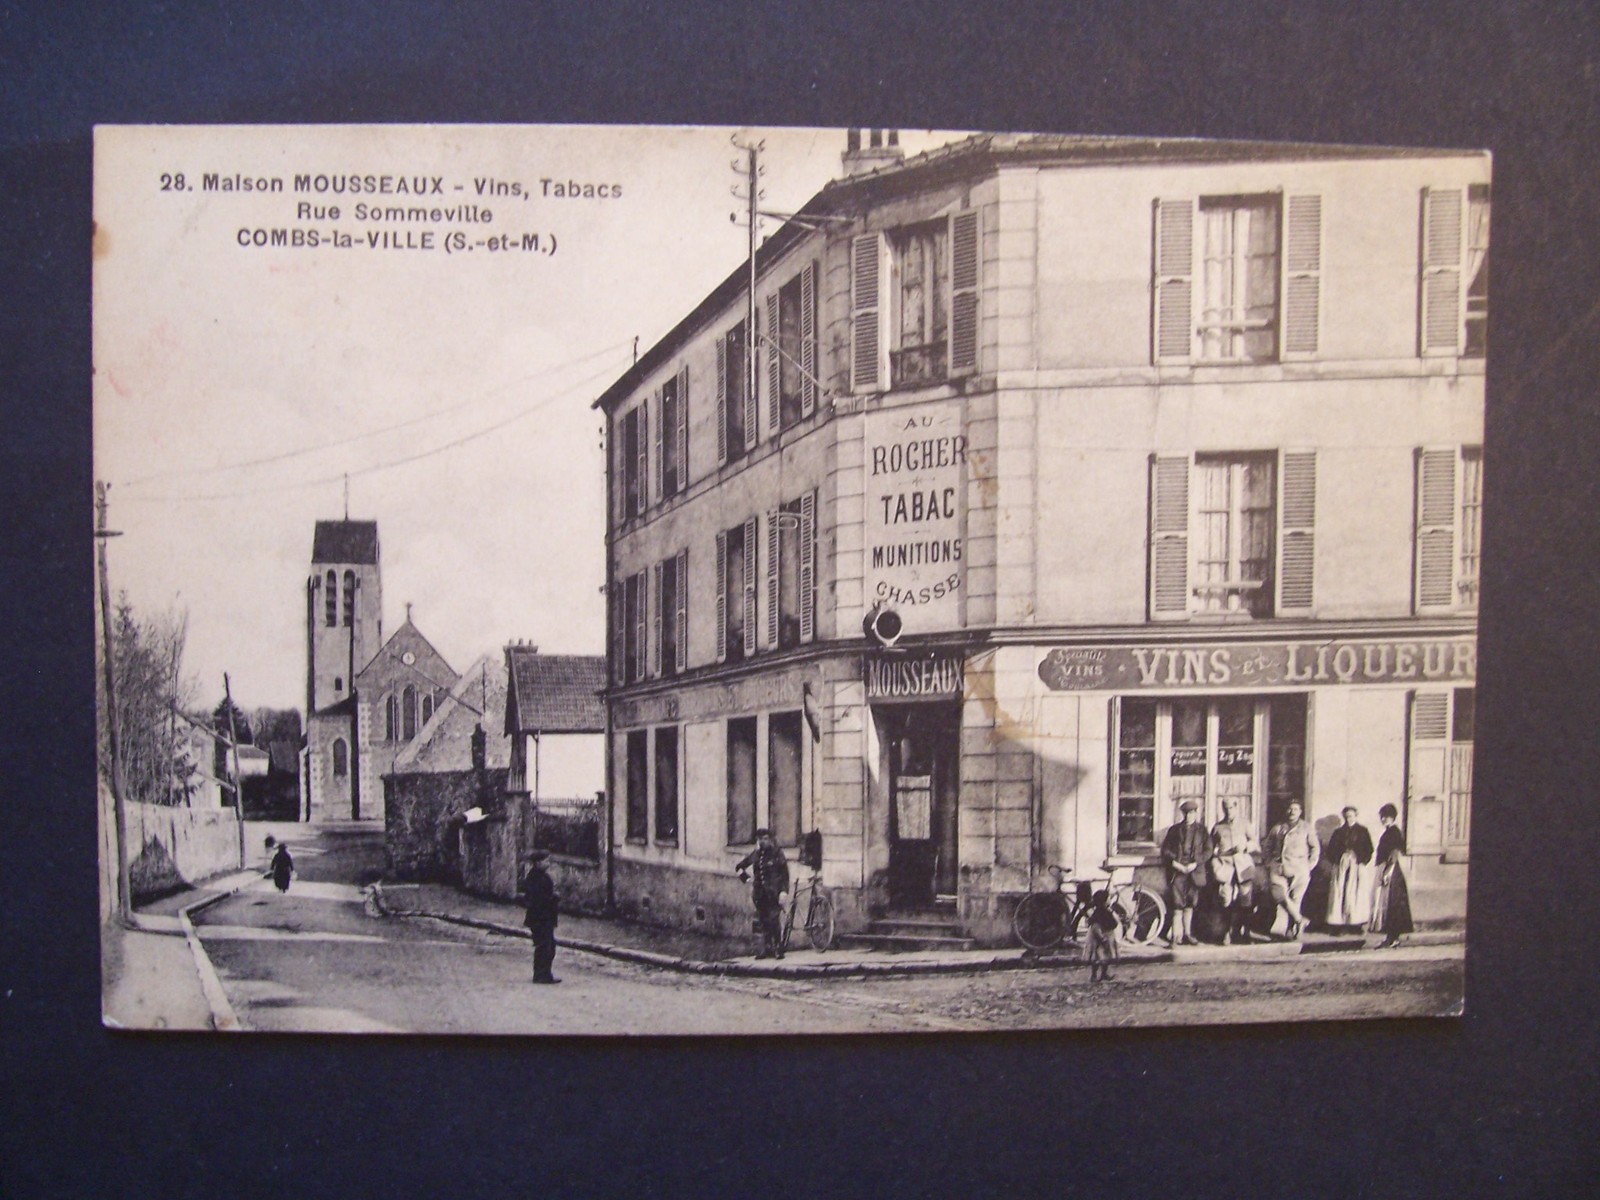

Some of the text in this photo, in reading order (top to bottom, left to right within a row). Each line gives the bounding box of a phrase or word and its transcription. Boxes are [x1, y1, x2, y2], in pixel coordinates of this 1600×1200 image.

[903, 415, 934, 432] AU
[872, 435, 969, 476] ROCHER
[881, 487, 956, 525] TABAC
[872, 538, 963, 569] MUNITIONS
[876, 573, 961, 606] CHASSE
[867, 658, 965, 698] MOUSSEAUX
[1060, 664, 1103, 677] VINS
[1131, 648, 1231, 685] VINS
[1283, 642, 1477, 682] LIQUEUR
